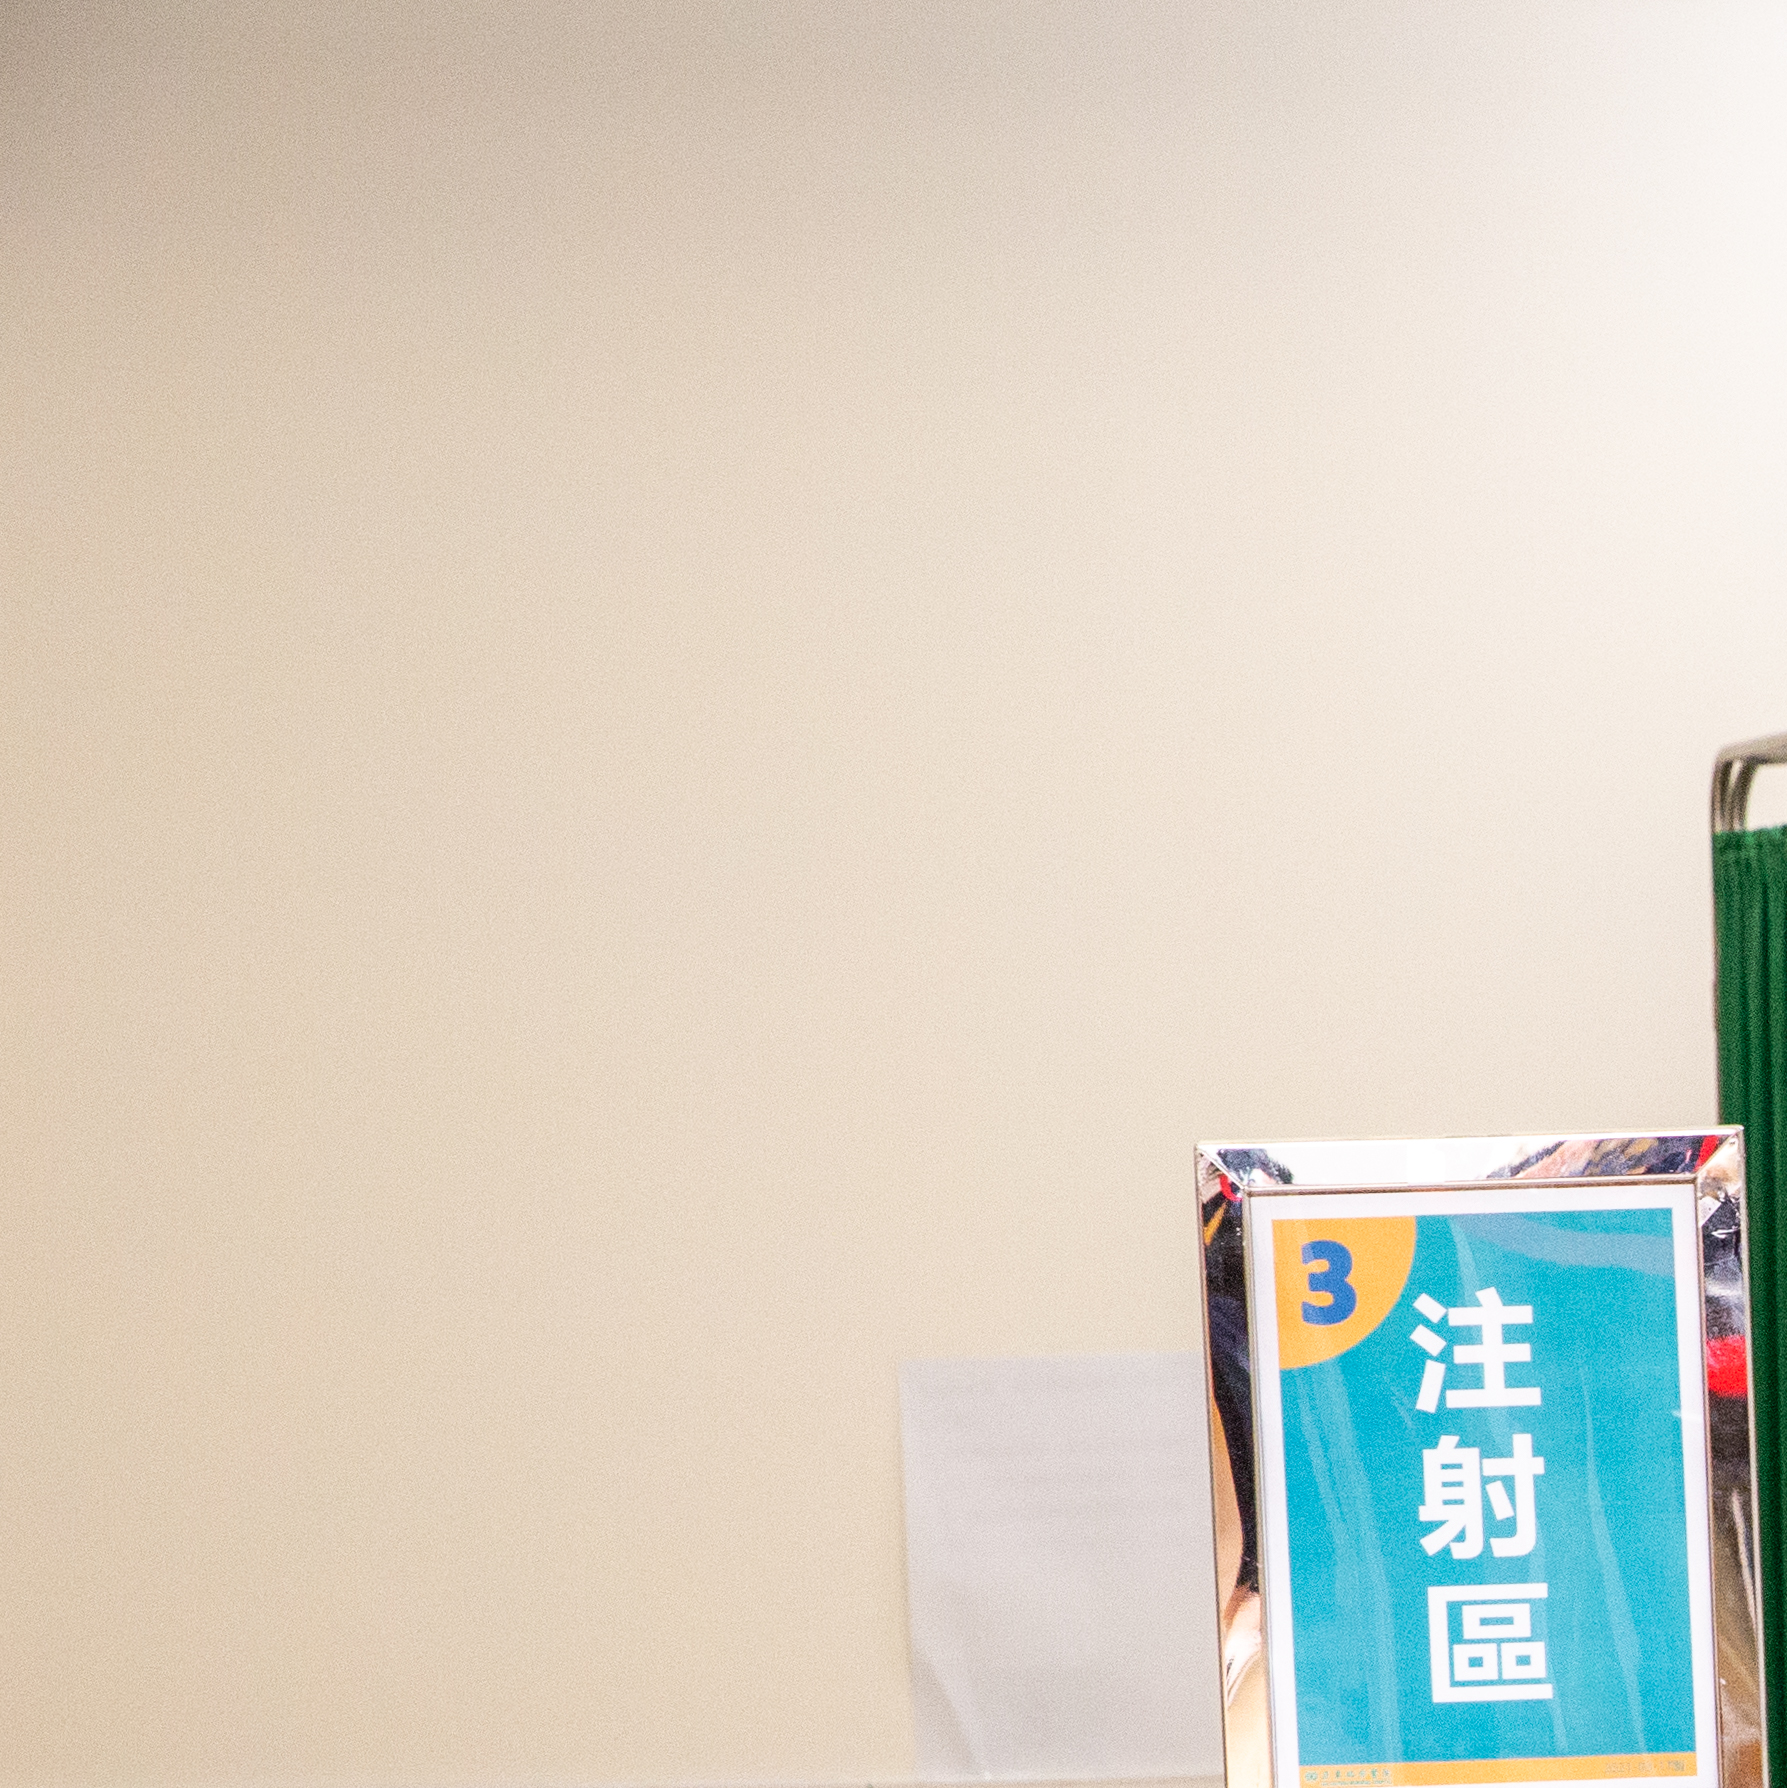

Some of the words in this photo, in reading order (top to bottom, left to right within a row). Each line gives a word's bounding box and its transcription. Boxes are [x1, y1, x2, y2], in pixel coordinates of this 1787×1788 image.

[1300, 1239, 1358, 1327] 3
[1409, 1286, 1554, 1704] 注射區
